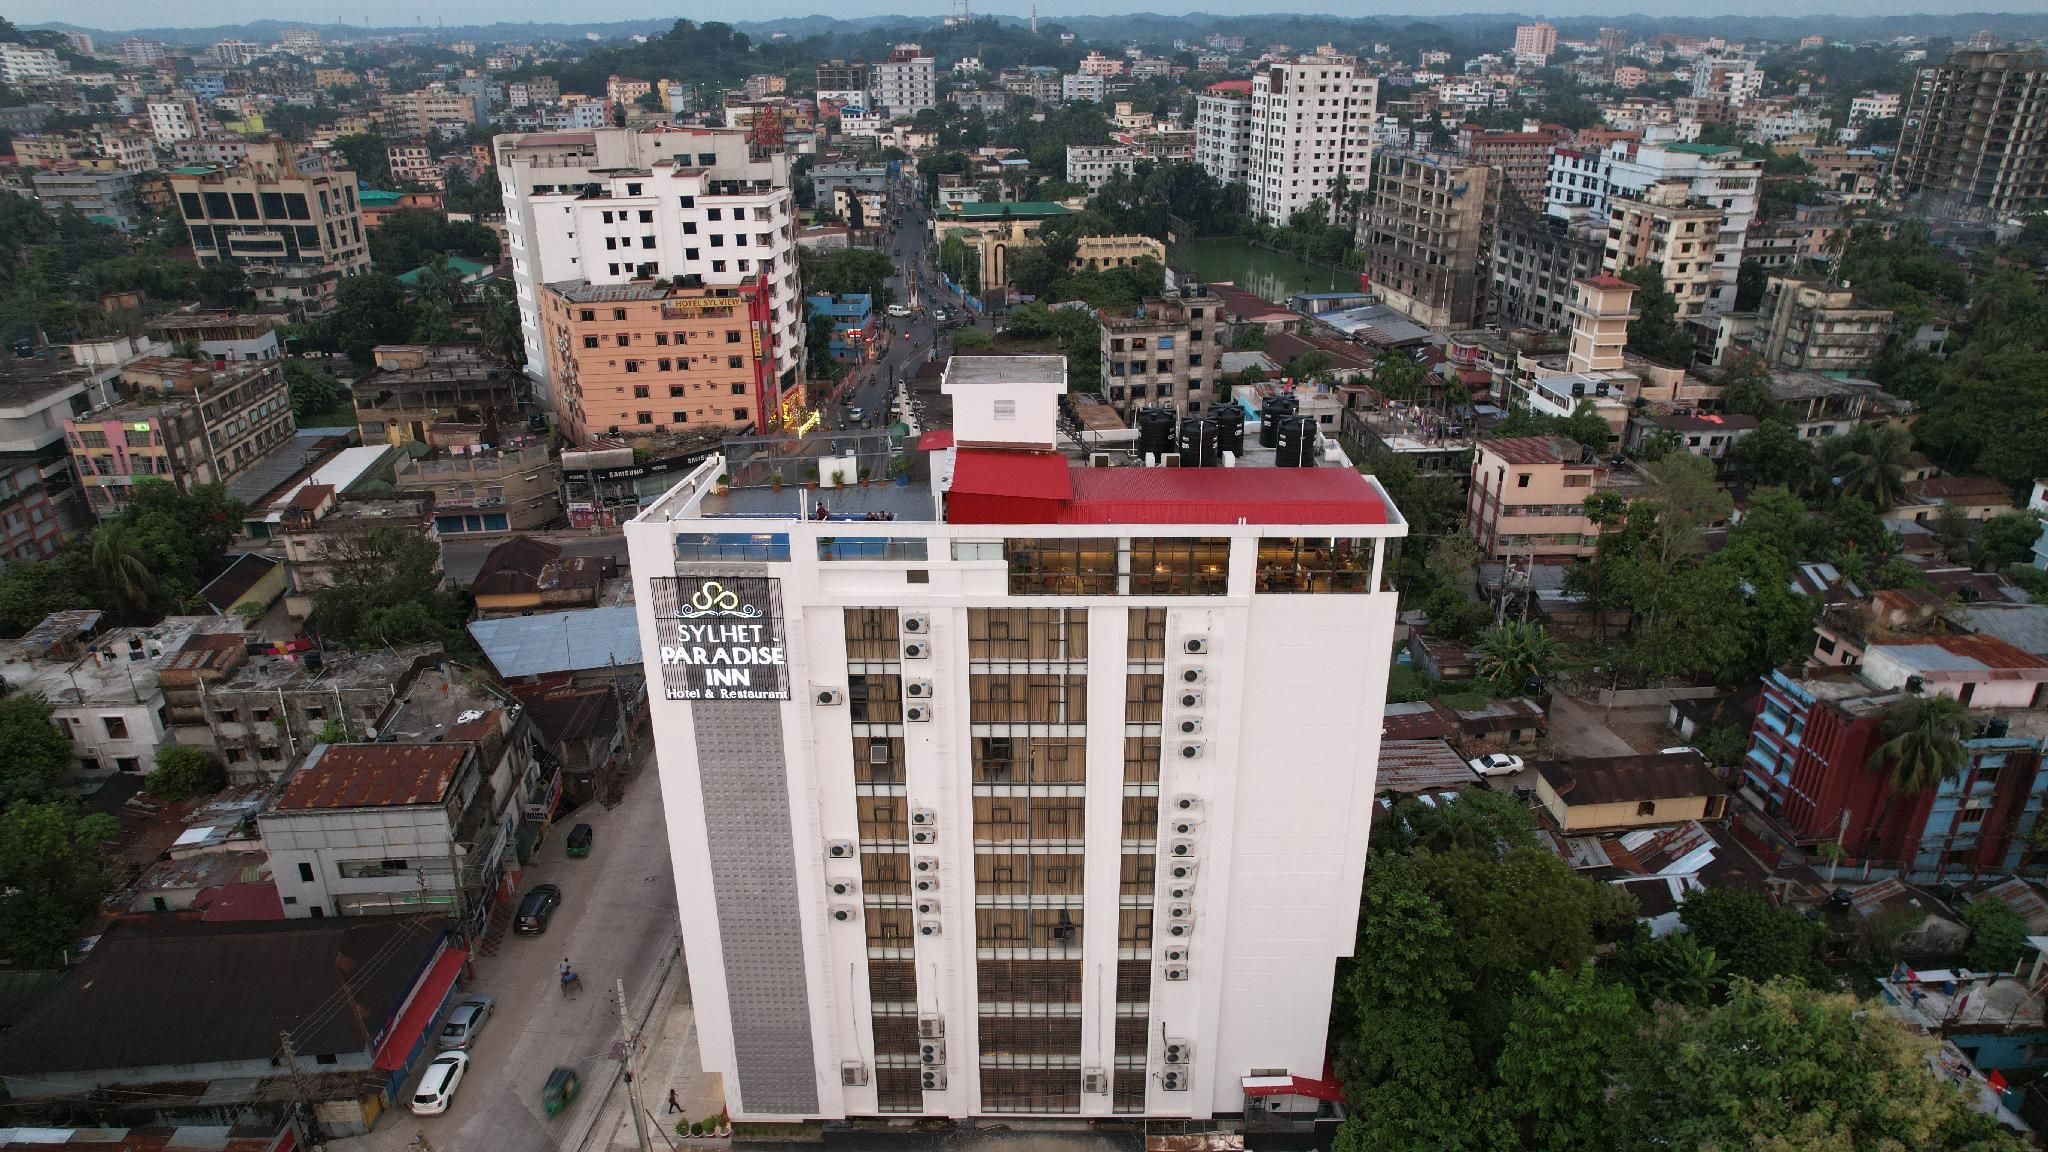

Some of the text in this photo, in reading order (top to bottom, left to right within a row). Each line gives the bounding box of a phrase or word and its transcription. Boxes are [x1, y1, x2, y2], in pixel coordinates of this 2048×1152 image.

[609, 468, 644, 478] SAMSUNG
[677, 624, 763, 643] SYLHET
[660, 646, 785, 665] PARADISE
[705, 668, 751, 686] INN
[666, 688, 789, 699] Hotel & Restaurant
